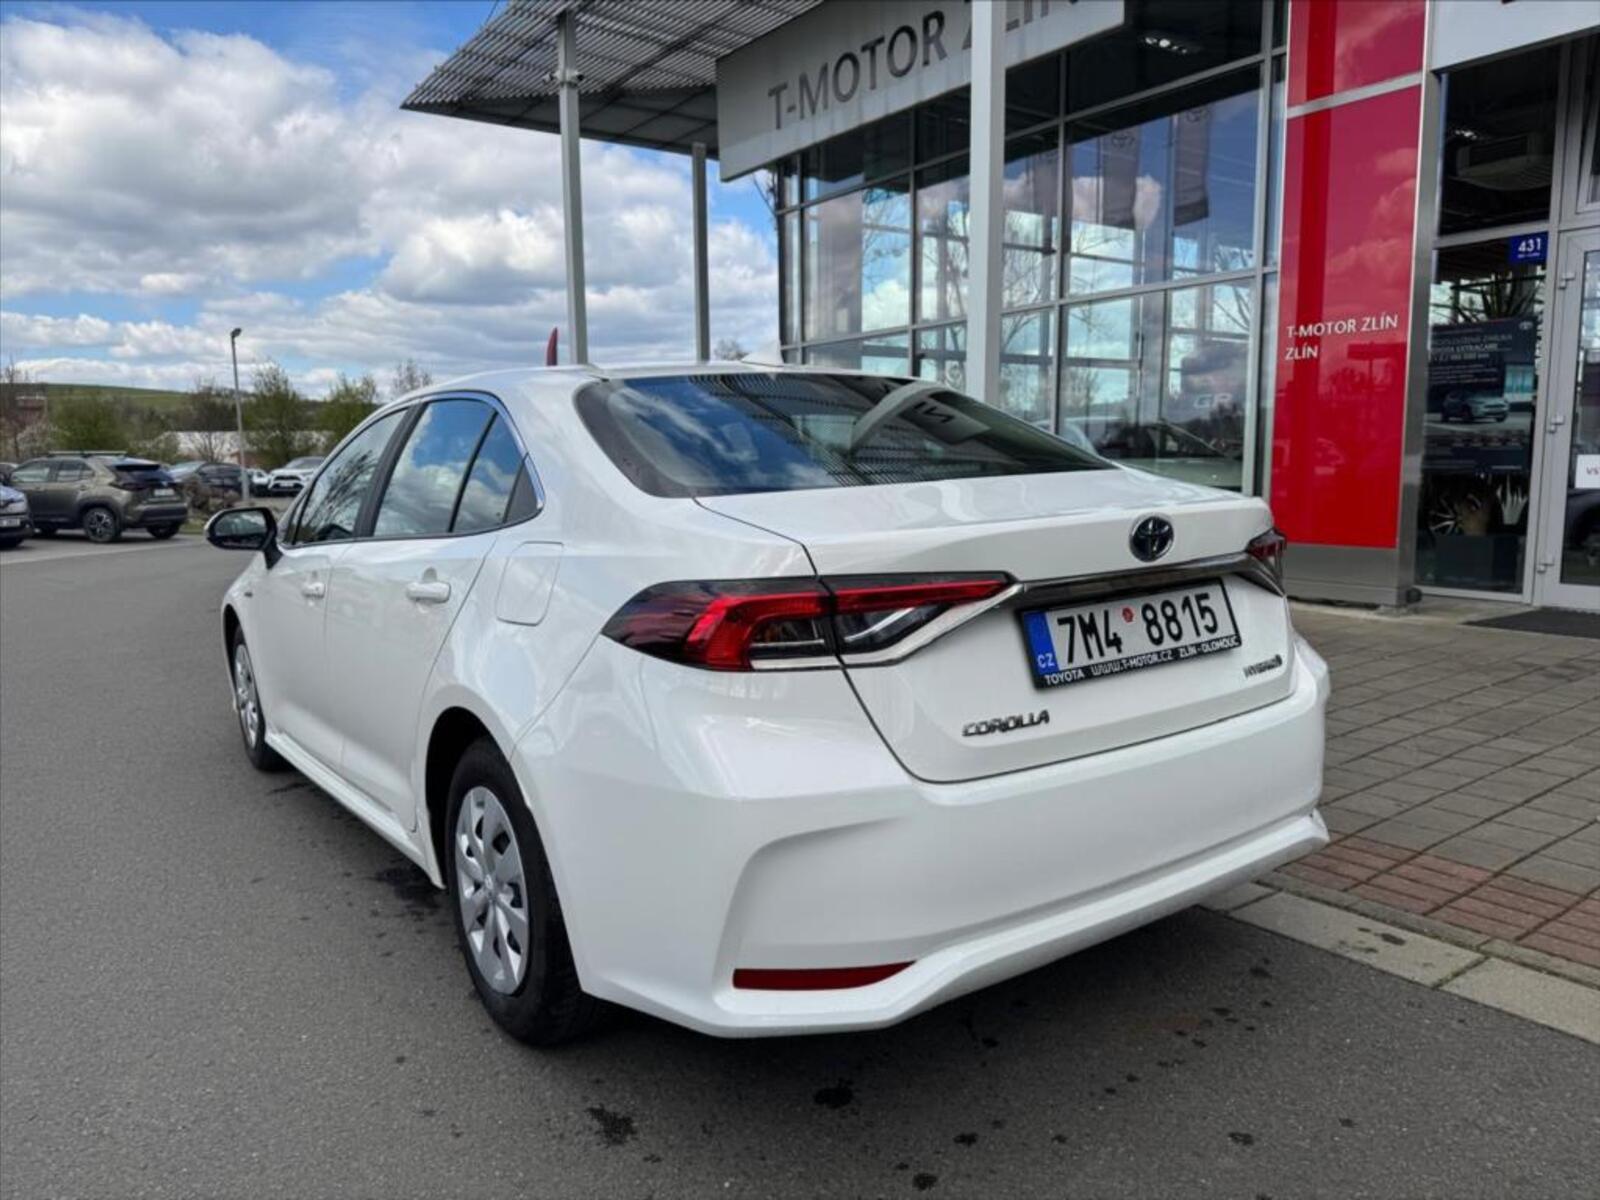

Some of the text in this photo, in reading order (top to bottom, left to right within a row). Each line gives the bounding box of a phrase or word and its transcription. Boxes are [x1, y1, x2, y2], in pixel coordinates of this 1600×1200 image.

[768, 10, 948, 130] T-MOTOR
[1518, 237, 1541, 252] 431
[1287, 311, 1398, 338] T-MOTOR ZLÍN
[1284, 342, 1318, 361] ZLÍN
[1193, 392, 1232, 410] GR
[1057, 592, 1218, 664] 7M4 8815
[1037, 652, 1056, 669] CZ
[1044, 669, 1085, 685] TOYOTA
[962, 709, 1050, 737] COROLLA
